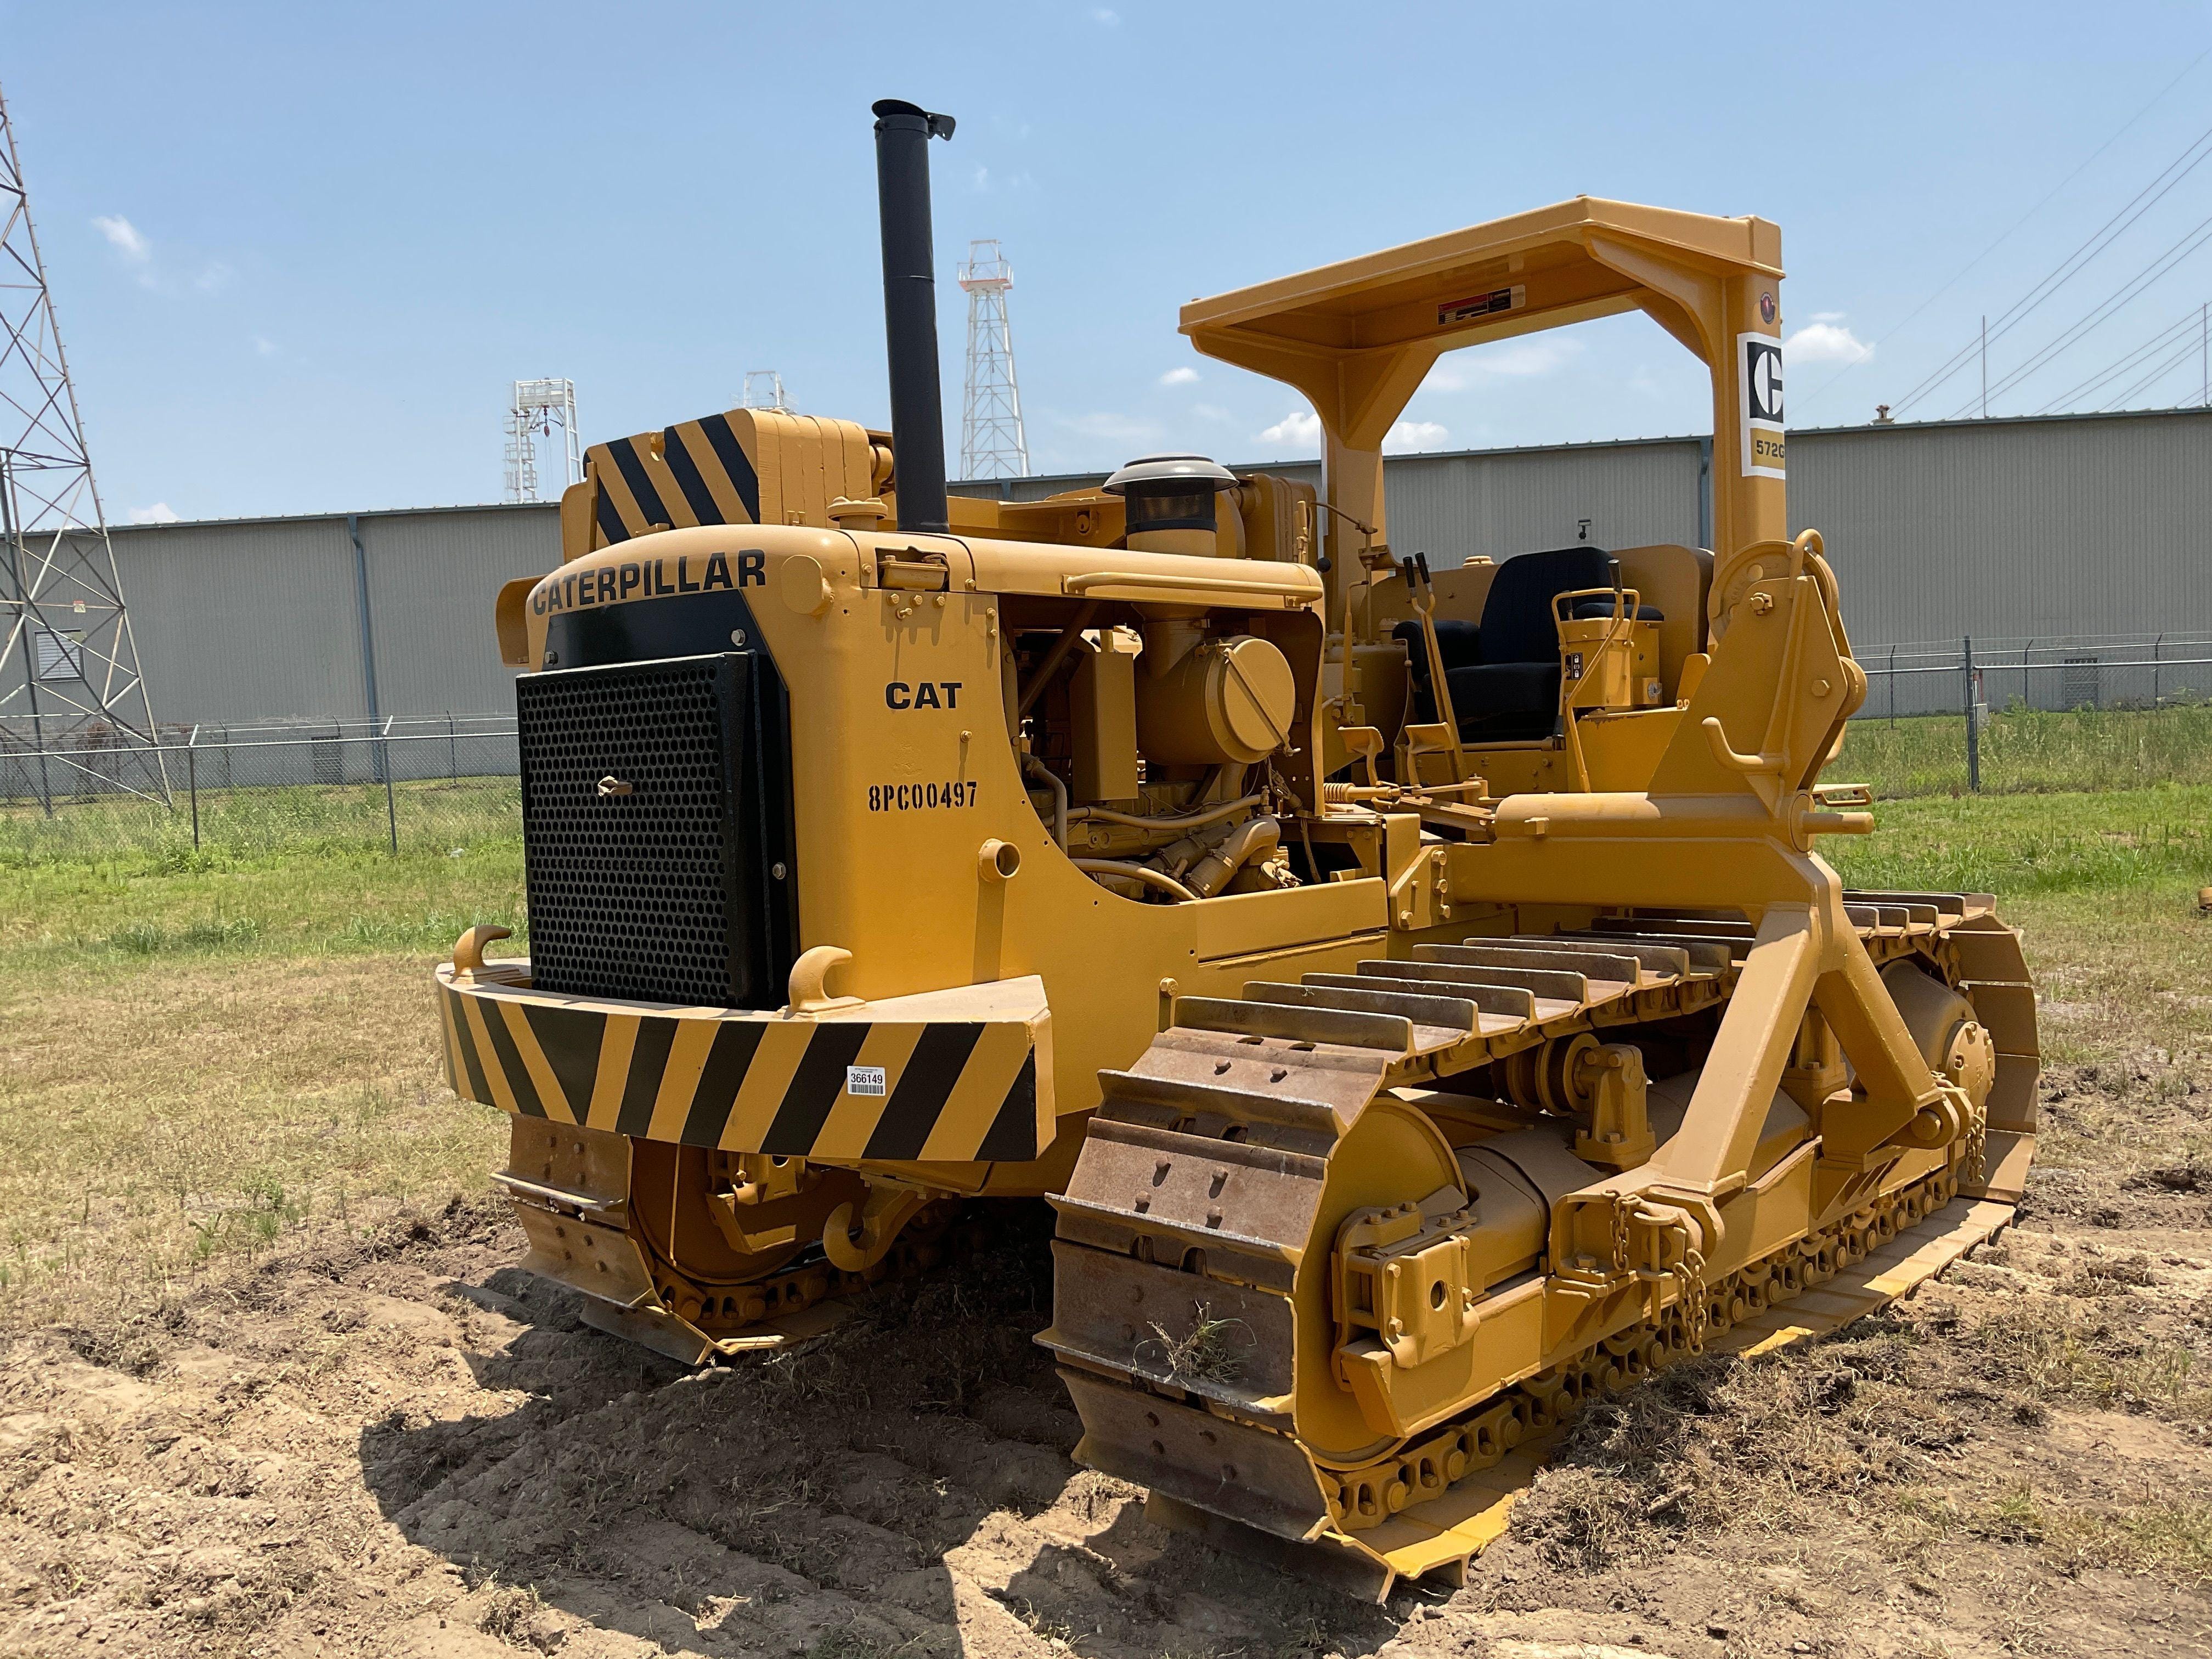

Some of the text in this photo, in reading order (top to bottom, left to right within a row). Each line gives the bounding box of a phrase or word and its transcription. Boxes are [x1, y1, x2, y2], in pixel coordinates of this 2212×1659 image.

[1756, 439, 1784, 458] 572G
[533, 549, 766, 616] CATERPILLAR
[885, 682, 962, 709] CAT
[869, 781, 977, 811] 8PC00497
[851, 1073, 883, 1084] 366149
